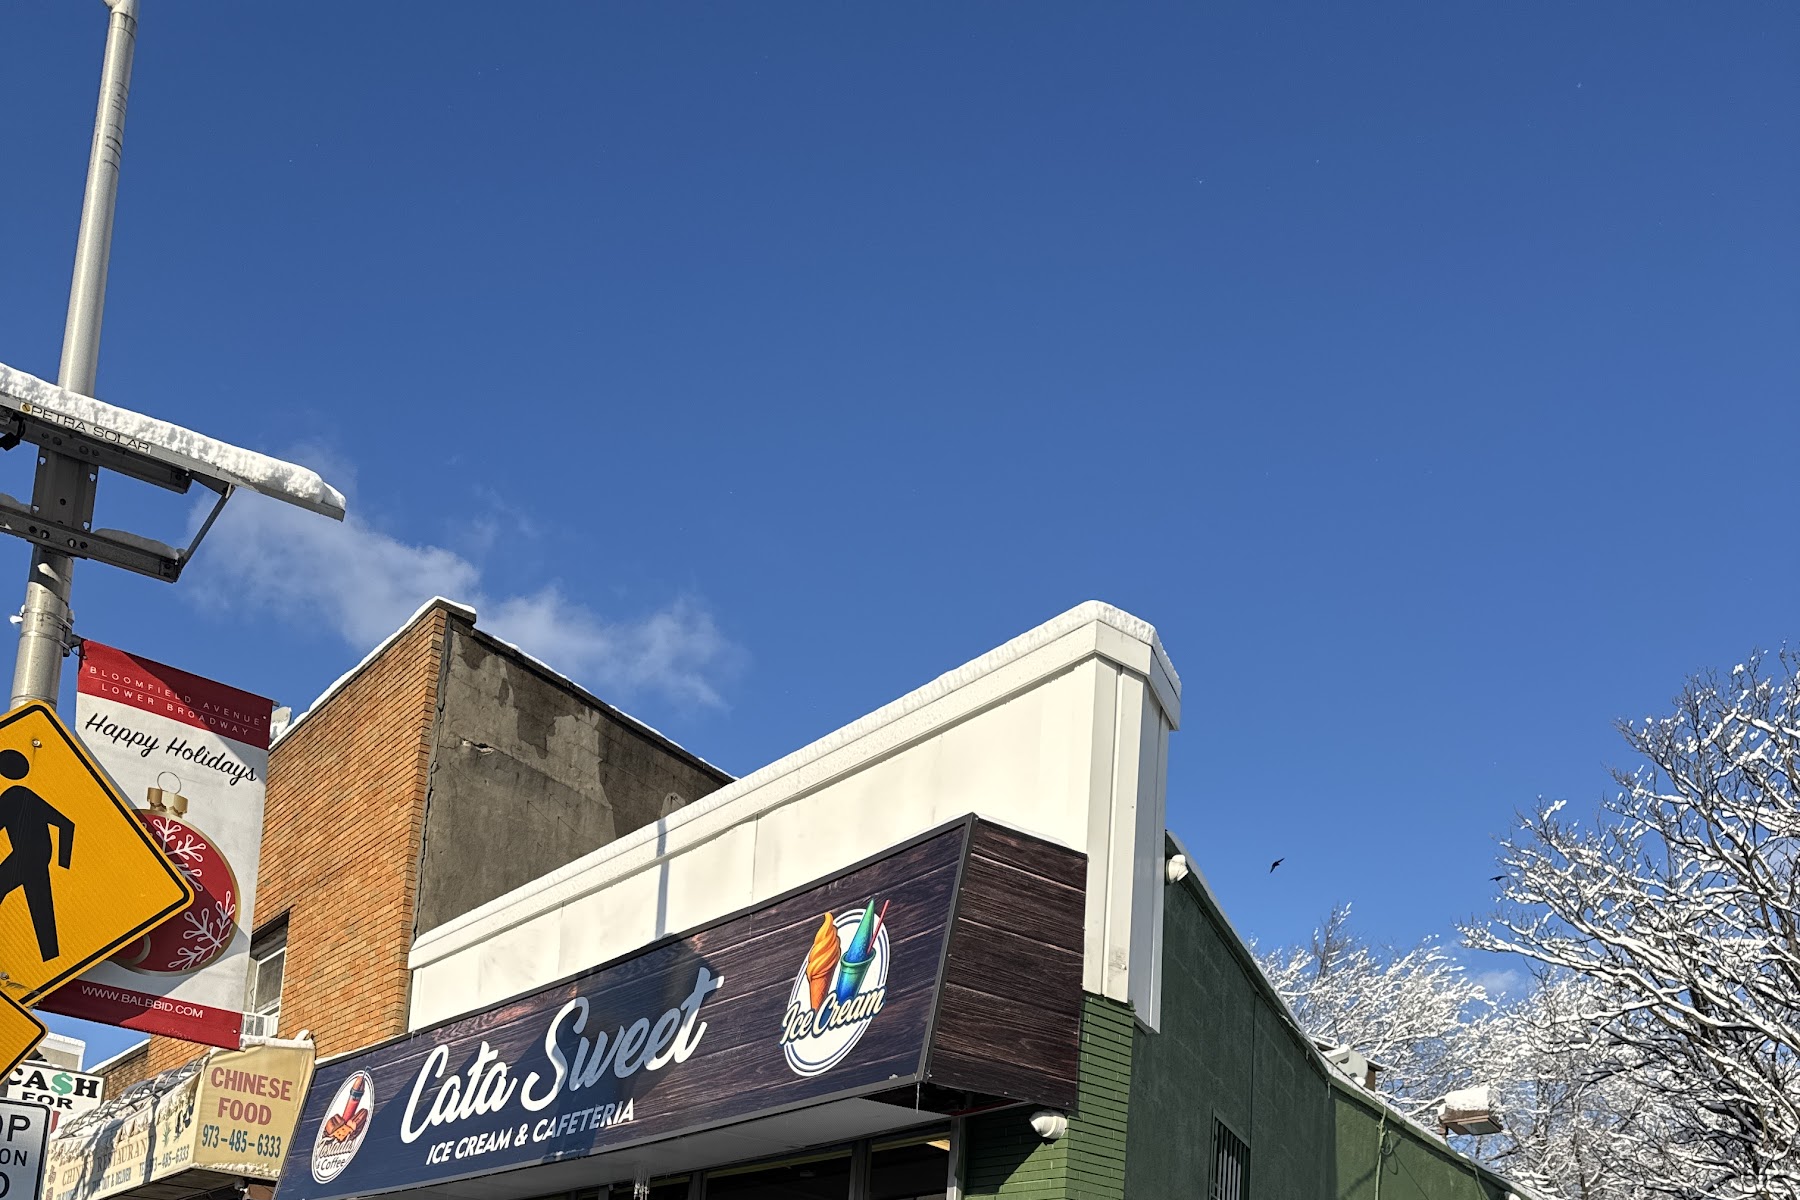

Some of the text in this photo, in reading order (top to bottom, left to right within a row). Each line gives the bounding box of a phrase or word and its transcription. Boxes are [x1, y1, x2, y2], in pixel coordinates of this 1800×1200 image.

[31, 405, 149, 454] PETRA SOLAR
[89, 666, 261, 726] BLOOMFIELD AVENUE
[101, 683, 249, 736] LOWER BROADWAY
[85, 713, 257, 787] Happy Holidays
[81, 985, 204, 1019] WWW.BALBBID.COM
[779, 988, 886, 1047] Ice Cream
[400, 966, 724, 1144] Cata Sweet
[22, 1091, 74, 1110] FOR
[210, 1067, 293, 1102] CHINESE
[217, 1097, 272, 1126] FOOD
[425, 1098, 635, 1166] ICE CREAM & CAFETERIA
[202, 1124, 282, 1158] 973-485-6333
[321, 1157, 345, 1171] Coffee
